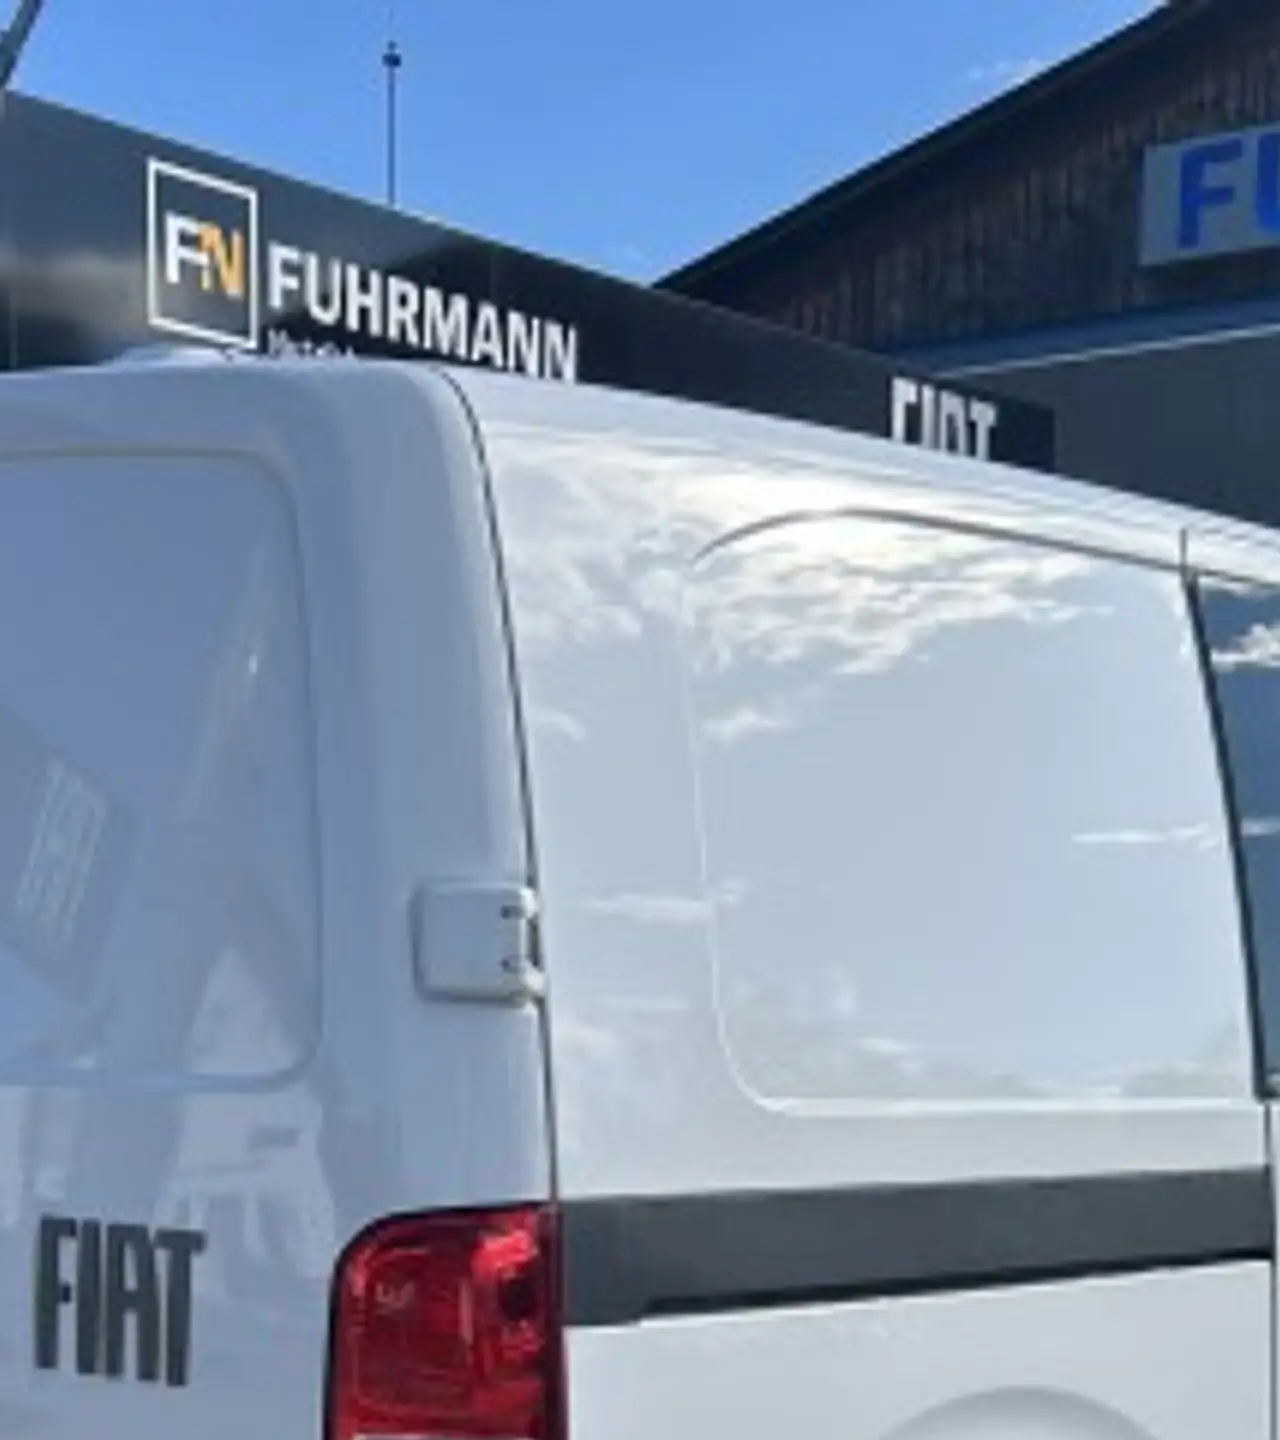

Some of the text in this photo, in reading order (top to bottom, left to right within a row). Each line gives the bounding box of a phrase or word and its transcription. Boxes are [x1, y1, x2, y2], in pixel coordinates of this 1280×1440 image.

[267, 240, 578, 384] FUHRMANN
[891, 376, 997, 460] FIAT
[34, 1213, 207, 1388] FIAT
